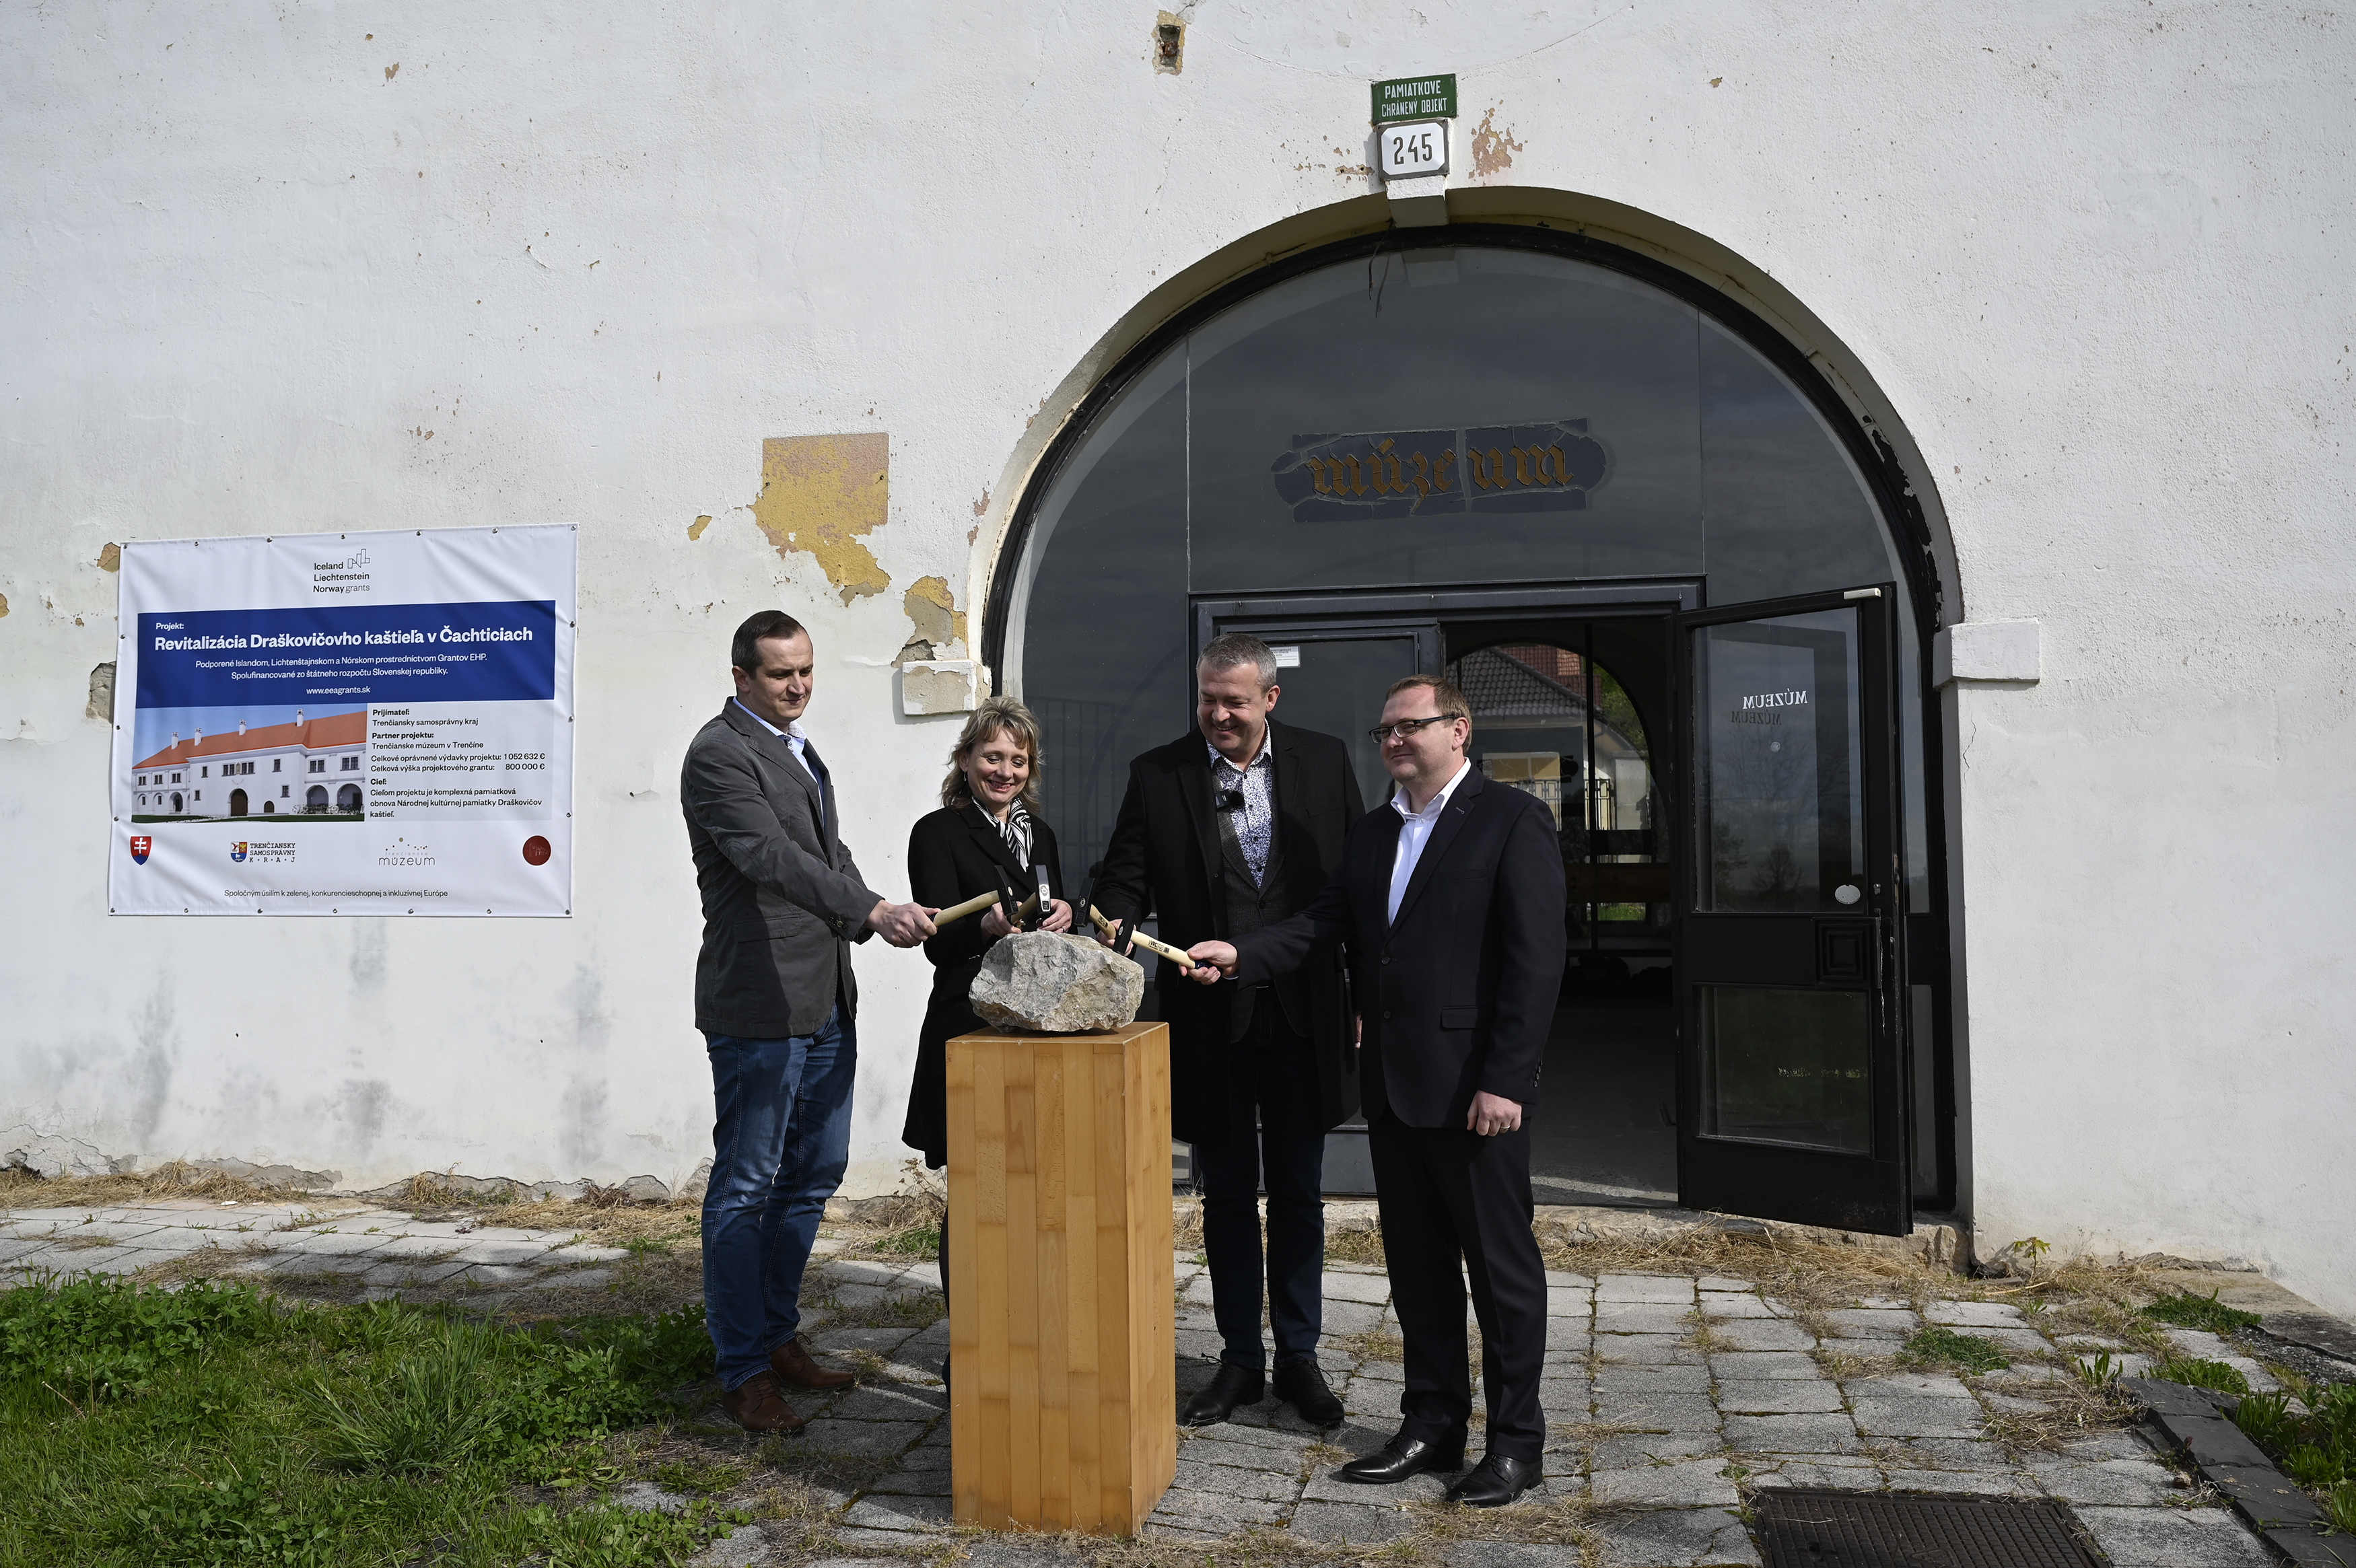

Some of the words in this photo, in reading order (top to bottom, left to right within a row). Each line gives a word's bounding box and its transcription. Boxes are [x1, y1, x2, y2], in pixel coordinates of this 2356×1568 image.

[1385, 80, 1441, 98] PAMIATKOVE
[1382, 98, 1418, 117] CHRÁNENÝ
[1421, 98, 1447, 113] OBJEKT
[1393, 133, 1432, 165] 245
[314, 562, 343, 570] Iceland
[314, 572, 370, 581] Liechtenstein
[313, 585, 345, 594] Norway
[345, 585, 370, 594] grants
[155, 622, 184, 631] Projekt:
[155, 635, 247, 651] Revitalizácia
[250, 631, 361, 648] Draškovičovho
[365, 630, 424, 644] kaštieľa
[427, 633, 437, 643] v
[440, 625, 532, 642] Čachticiach
[195, 660, 234, 669] Podporené
[236, 660, 270, 668] Islandom,
[271, 658, 335, 666] Lichtenštajnskom
[376, 654, 436, 664] prostredníctvom
[231, 671, 295, 680] Spolufinancované
[339, 669, 372, 677] rozpočtu
[372, 668, 411, 676] Slovenskej
[413, 667, 448, 676] republiky.
[306, 686, 370, 694] www.eeagrants.sk
[373, 709, 410, 717] Prijímateľ:
[373, 719, 415, 727] Trenčiansky
[416, 719, 463, 727] samosprávny
[465, 718, 479, 726] kraj
[401, 732, 434, 740] projektu:
[401, 754, 437, 762] oprávnené
[422, 764, 468, 773] projektového
[396, 789, 425, 797] projektu
[434, 788, 472, 796] komplexná
[379, 857, 435, 865] múzeum
[224, 890, 261, 898] Spoločným
[286, 890, 310, 898] zelenej,
[312, 890, 382, 898] konkurencieschopnej
[388, 890, 423, 898] inkluzívnej
[424, 890, 448, 898] Európe
